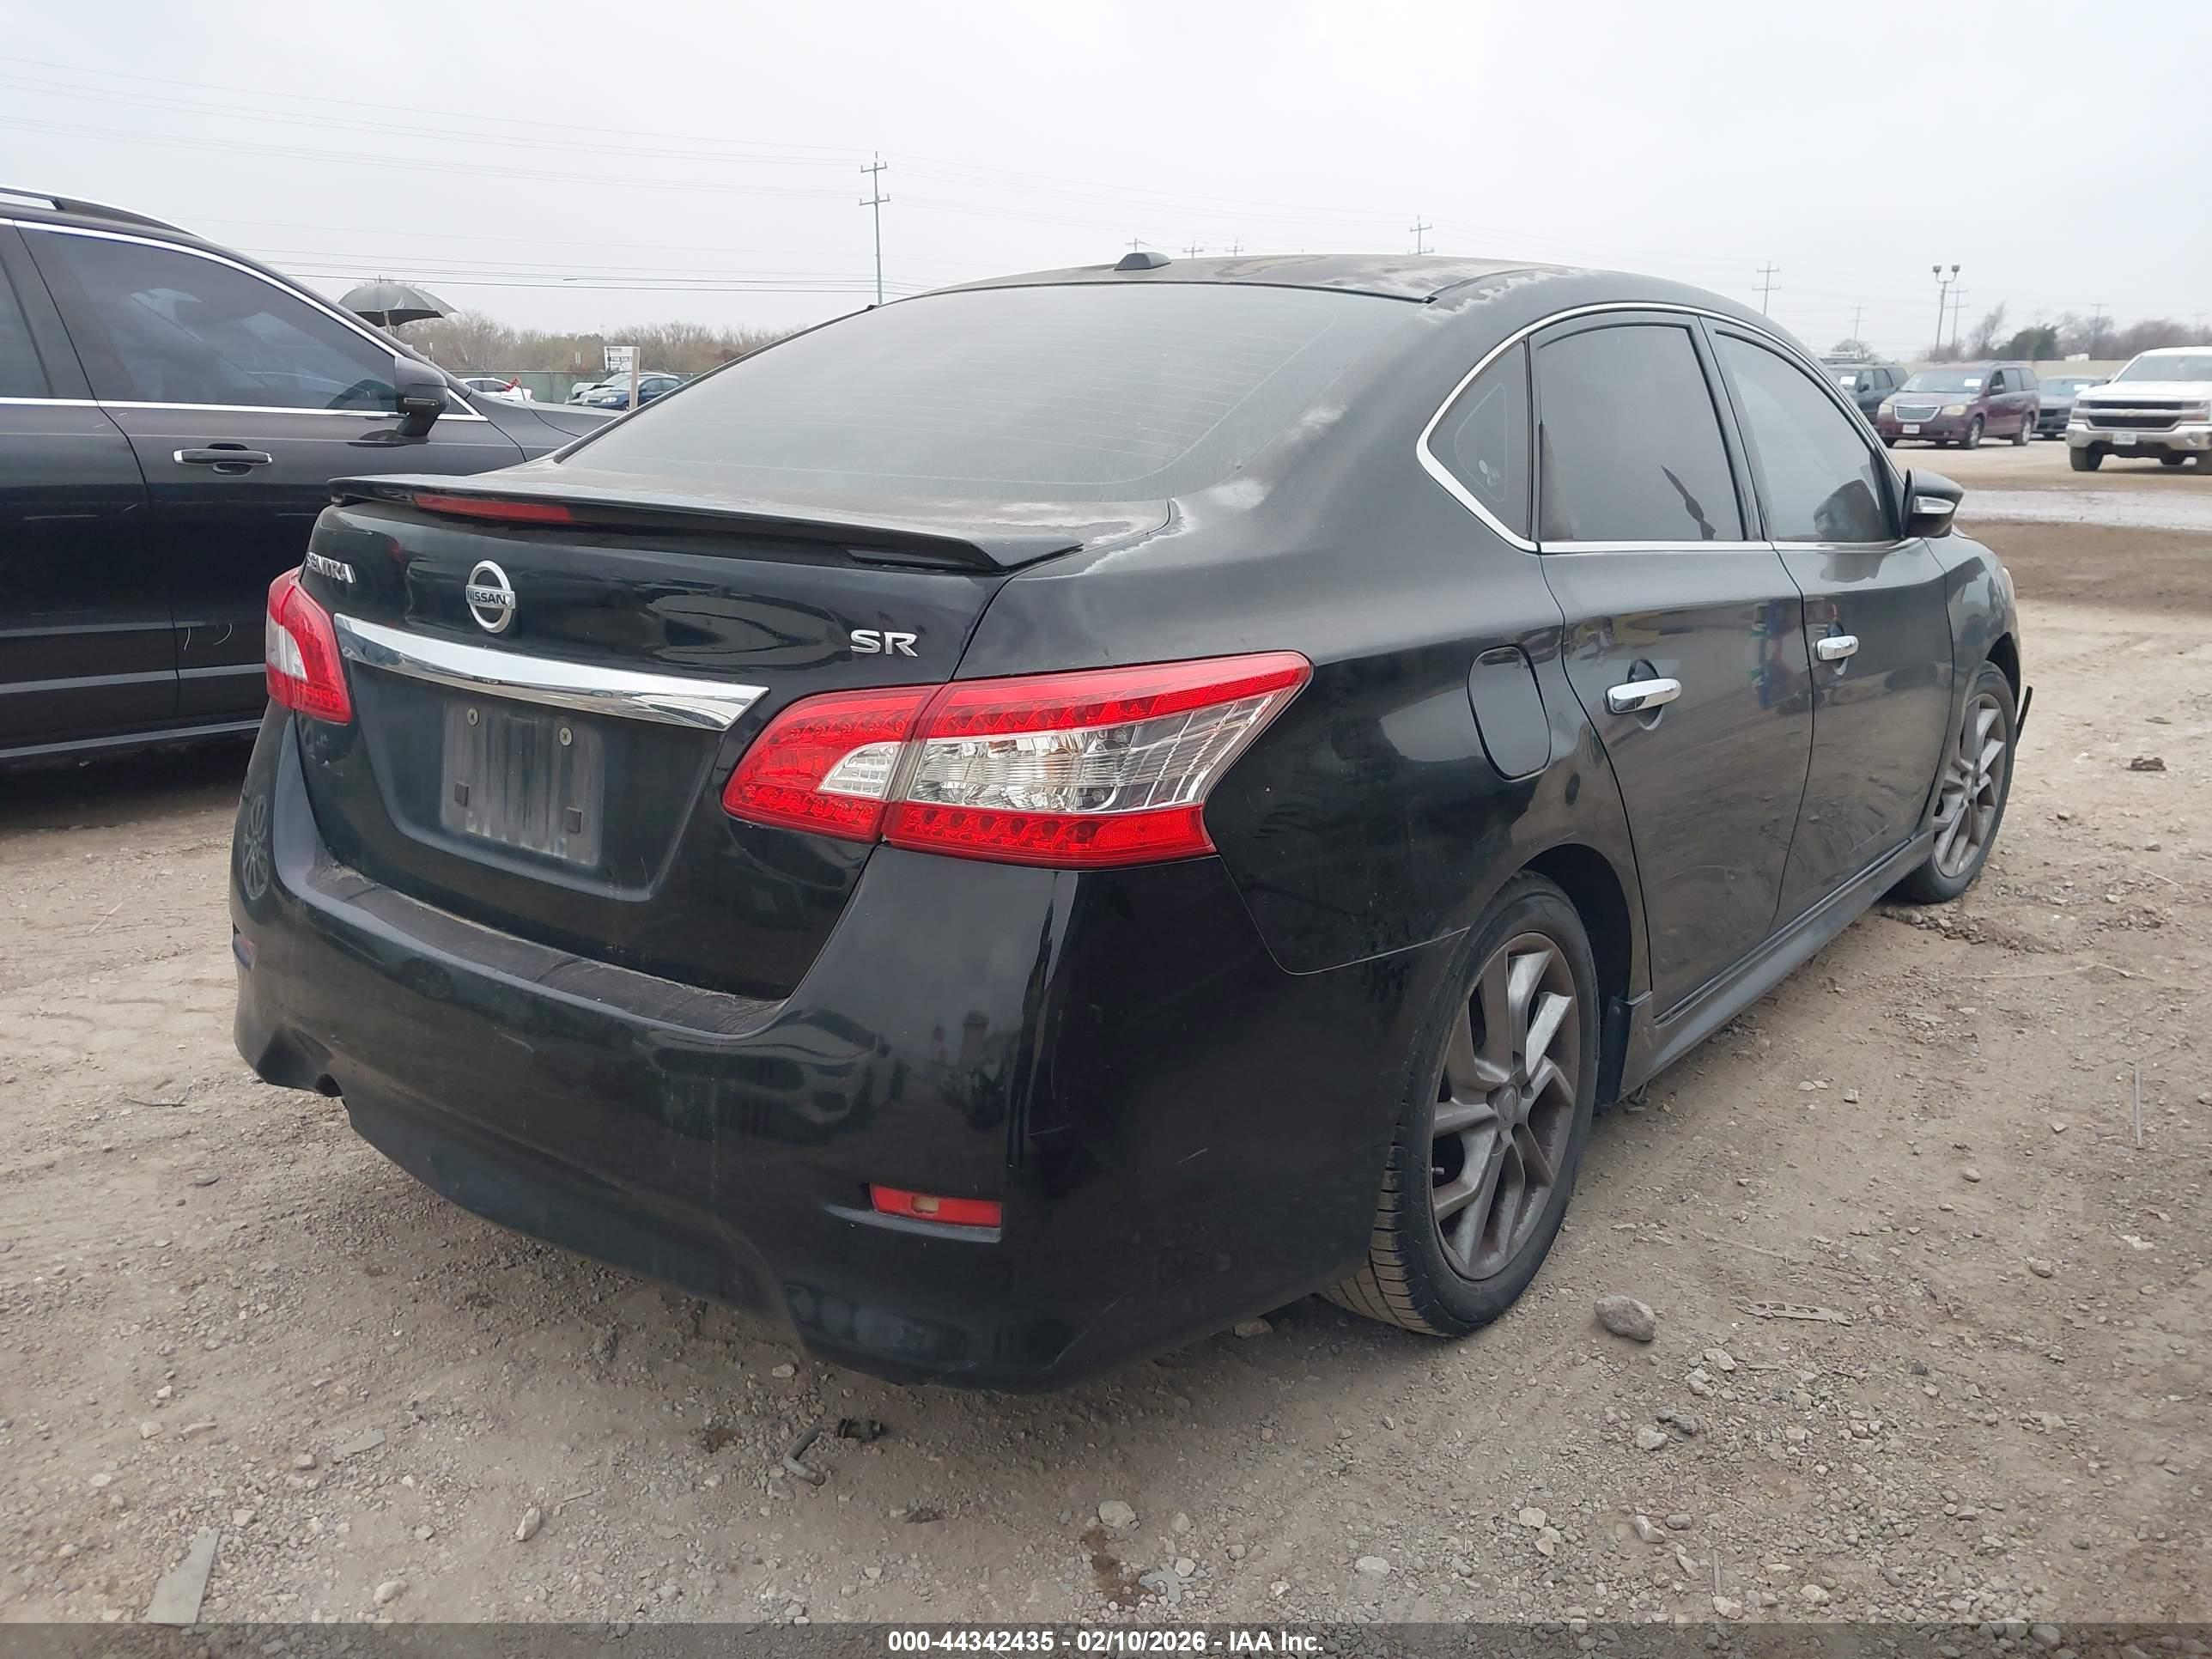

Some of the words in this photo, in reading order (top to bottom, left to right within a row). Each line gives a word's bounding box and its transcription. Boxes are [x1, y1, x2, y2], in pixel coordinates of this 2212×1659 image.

[307, 552, 356, 583] SENTRA
[467, 590, 507, 605] NISSAN
[850, 629, 918, 658] SR
